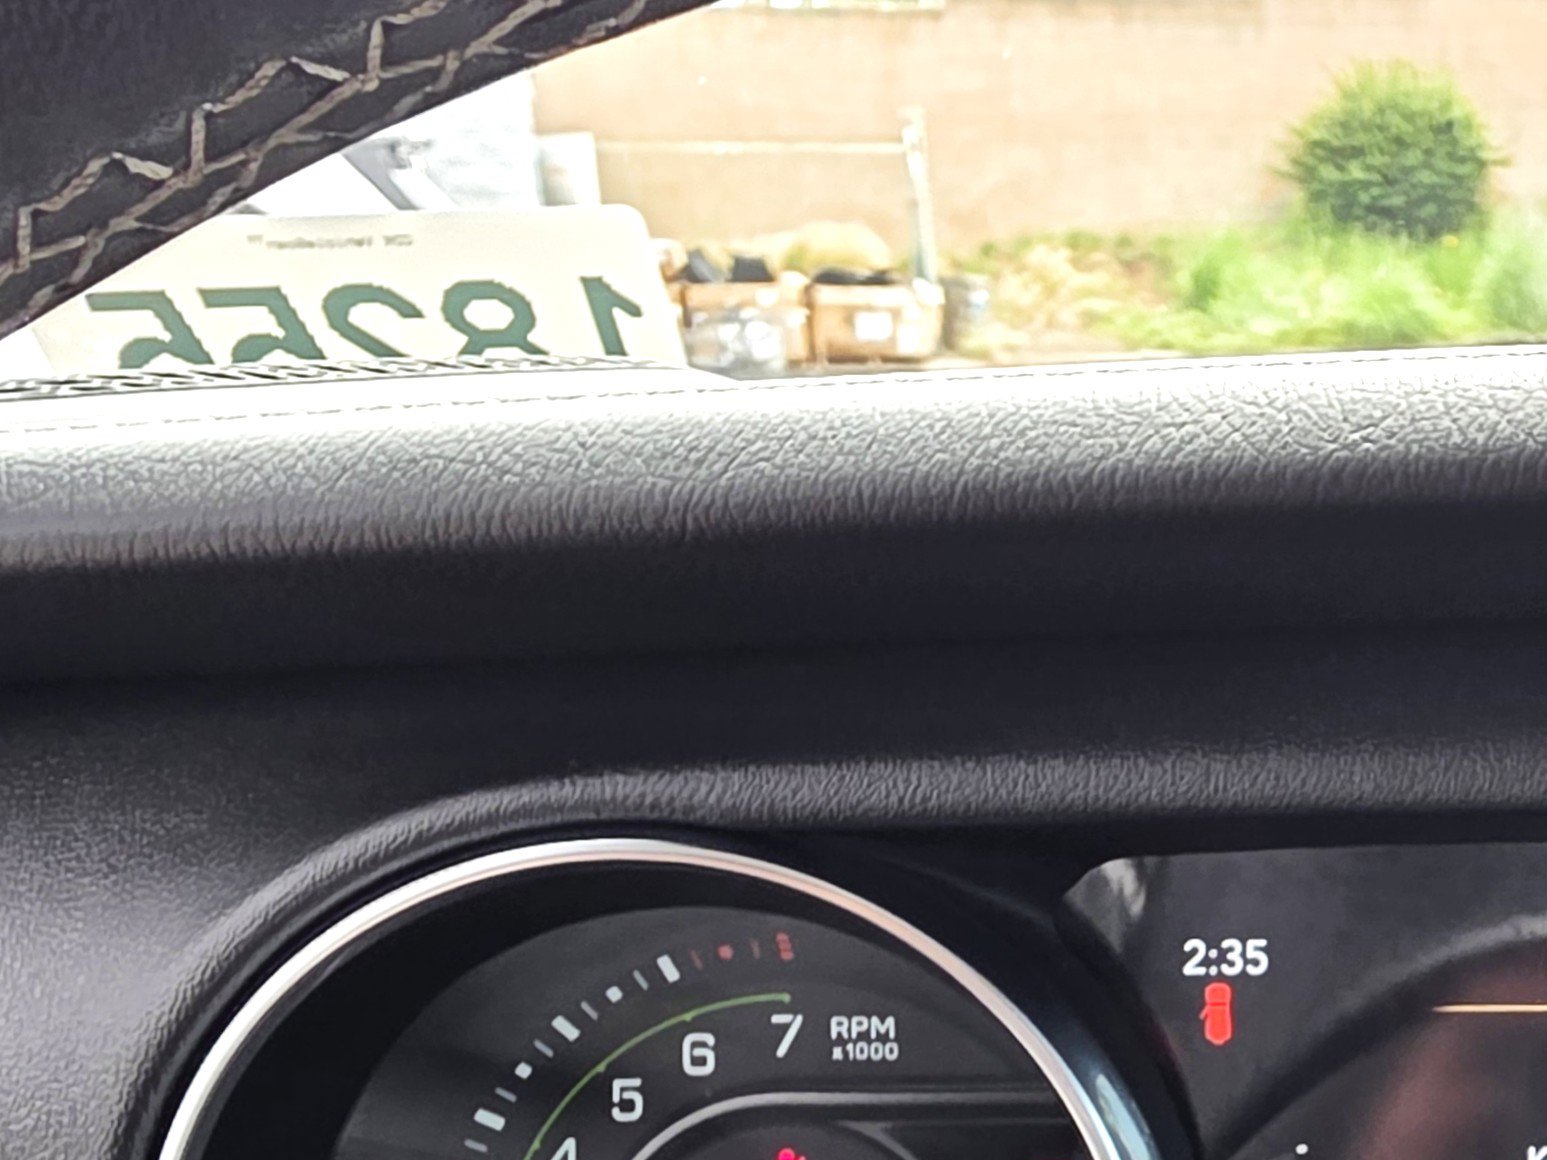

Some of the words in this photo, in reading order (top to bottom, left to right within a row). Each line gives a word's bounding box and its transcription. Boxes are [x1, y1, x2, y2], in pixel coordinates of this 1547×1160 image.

[1183, 938, 1268, 976] 2:35
[771, 1014, 803, 1057] 7
[831, 1016, 895, 1040] RPM
[682, 1033, 715, 1076] 6
[612, 1078, 643, 1122] 5
